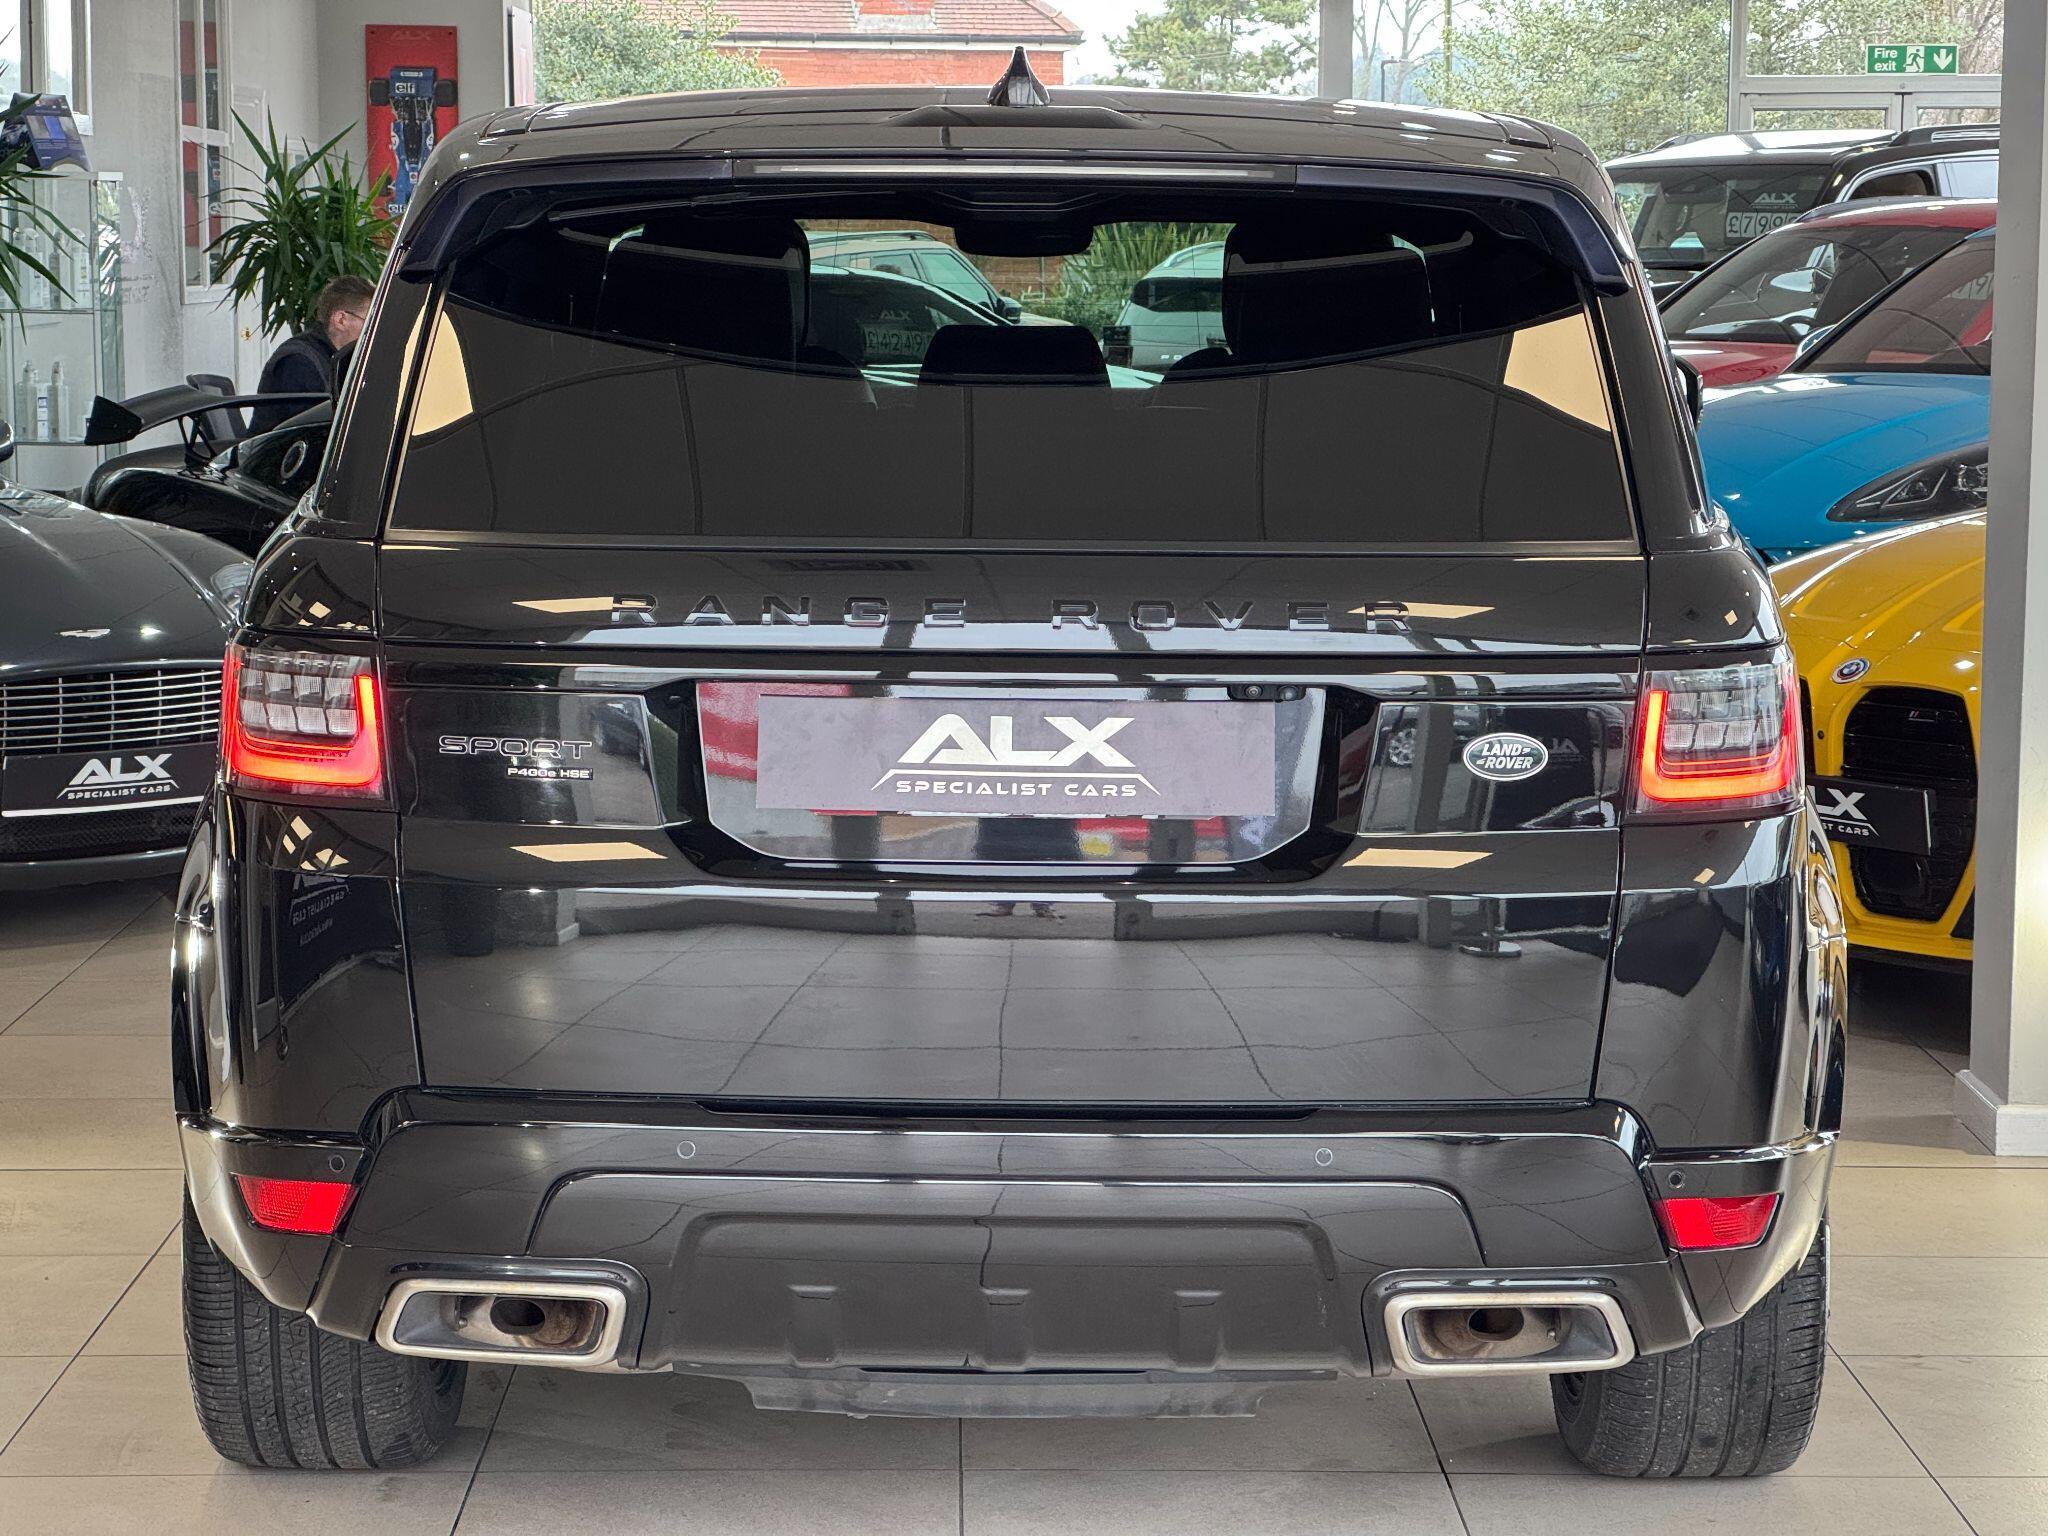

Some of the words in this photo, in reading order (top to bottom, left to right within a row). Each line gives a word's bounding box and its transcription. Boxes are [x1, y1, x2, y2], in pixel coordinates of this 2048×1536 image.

[1874, 47, 1898, 59] Fire
[1874, 60, 1897, 71] exit
[395, 82, 415, 94] elf
[1752, 192, 1797, 204] ALX
[611, 593, 968, 628] RANGE
[1051, 599, 1412, 632] ROVER
[896, 713, 1136, 768] ALX
[438, 735, 593, 760] SPORT
[1482, 743, 1523, 756] LAND
[1484, 756, 1534, 769] ROVER
[68, 753, 173, 786] ALX
[508, 767, 557, 778] P400e
[560, 768, 590, 779] HSE
[67, 788, 137, 800] SPECIALIST
[140, 784, 171, 794] CARS
[896, 780, 1052, 796] SPECIALIST
[1064, 783, 1137, 797] CARS
[1806, 785, 1868, 821] LX
[1838, 825, 1870, 836] CARS
